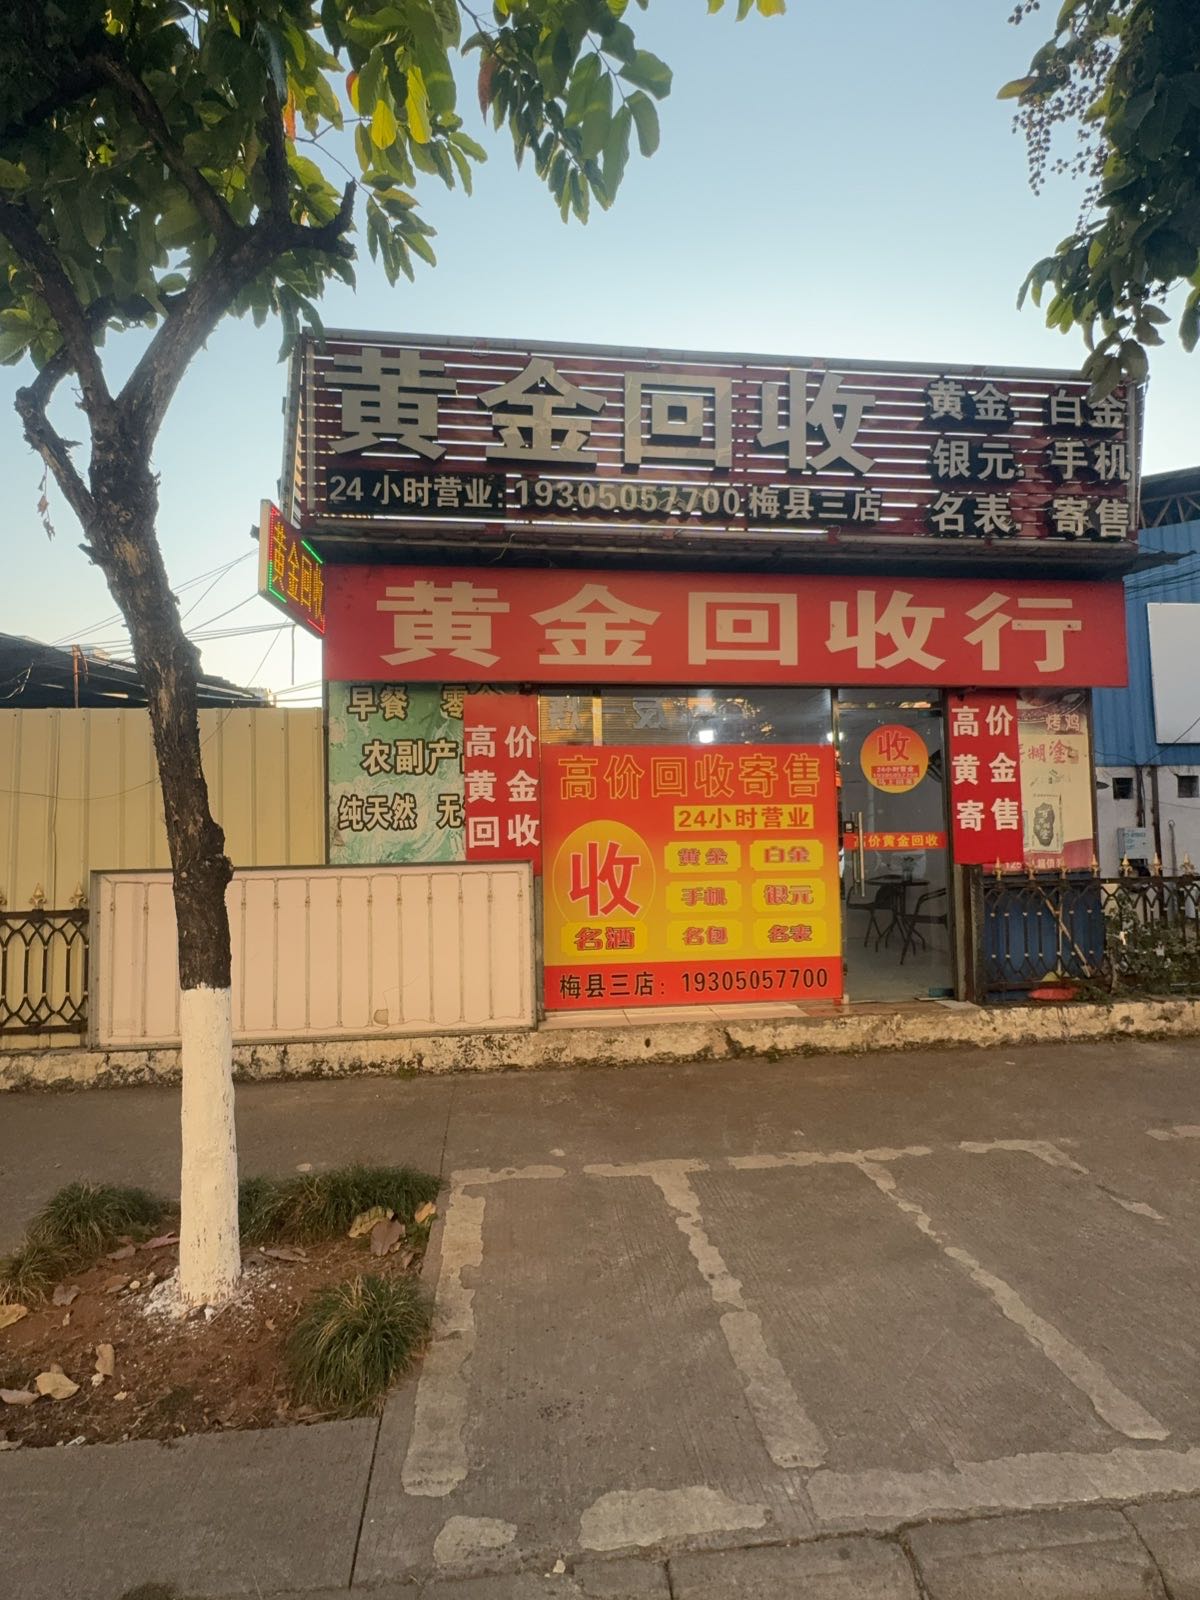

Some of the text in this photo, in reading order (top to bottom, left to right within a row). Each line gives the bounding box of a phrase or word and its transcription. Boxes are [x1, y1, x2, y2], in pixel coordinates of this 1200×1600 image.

[324, 347, 876, 473] 黄金回收
[1051, 389, 1126, 429] 白金
[1052, 441, 1130, 480] 手机
[515, 480, 741, 514] 19305057700
[749, 486, 881, 522] 梅县三店
[1052, 497, 1129, 538] 寄售
[376, 580, 1083, 673] 黄金回收行
[347, 684, 408, 721] 早餐
[952, 705, 1013, 737] 高价
[361, 739, 465, 776] 农副产
[464, 724, 537, 758] 高价
[878, 731, 910, 761] 收
[464, 769, 539, 803] 黄金
[558, 753, 820, 800] 高价回收寄售
[952, 752, 1017, 785] 黄金
[337, 793, 466, 831] 纯天然 无
[678, 805, 810, 828] 24小时营业
[956, 798, 1019, 832] 寄售
[467, 813, 540, 848] 回收
[678, 845, 810, 866] 黄金 白金
[568, 840, 641, 918] 收
[681, 884, 814, 906] 手机 银元
[574, 924, 813, 950] 名酒 名包 名表
[681, 968, 828, 992] 19305057700
